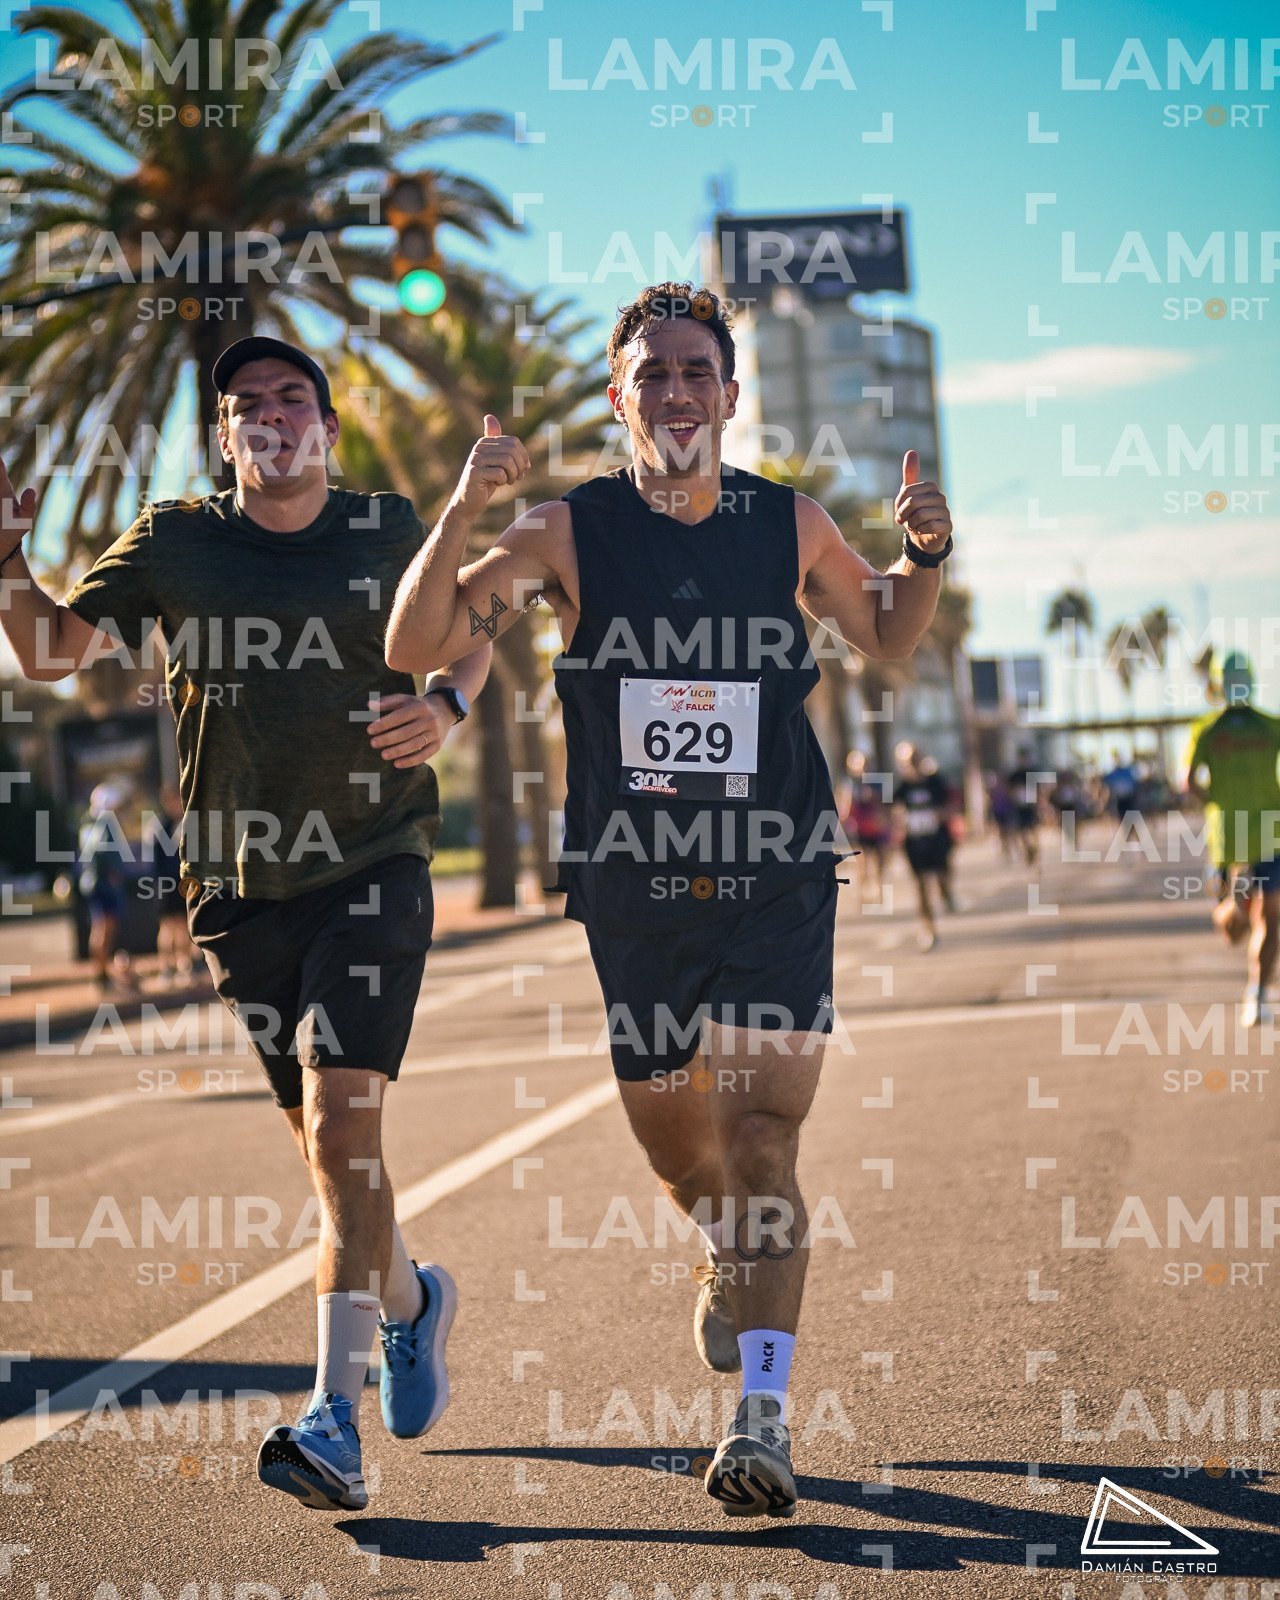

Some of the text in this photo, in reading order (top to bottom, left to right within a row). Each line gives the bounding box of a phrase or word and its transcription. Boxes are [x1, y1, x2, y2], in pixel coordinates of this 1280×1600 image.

[690, 689, 716, 698] ucm
[685, 703, 716, 712] FALCK
[643, 720, 733, 764] 629
[629, 771, 674, 790] 30K
[761, 1341, 775, 1373] PACK
